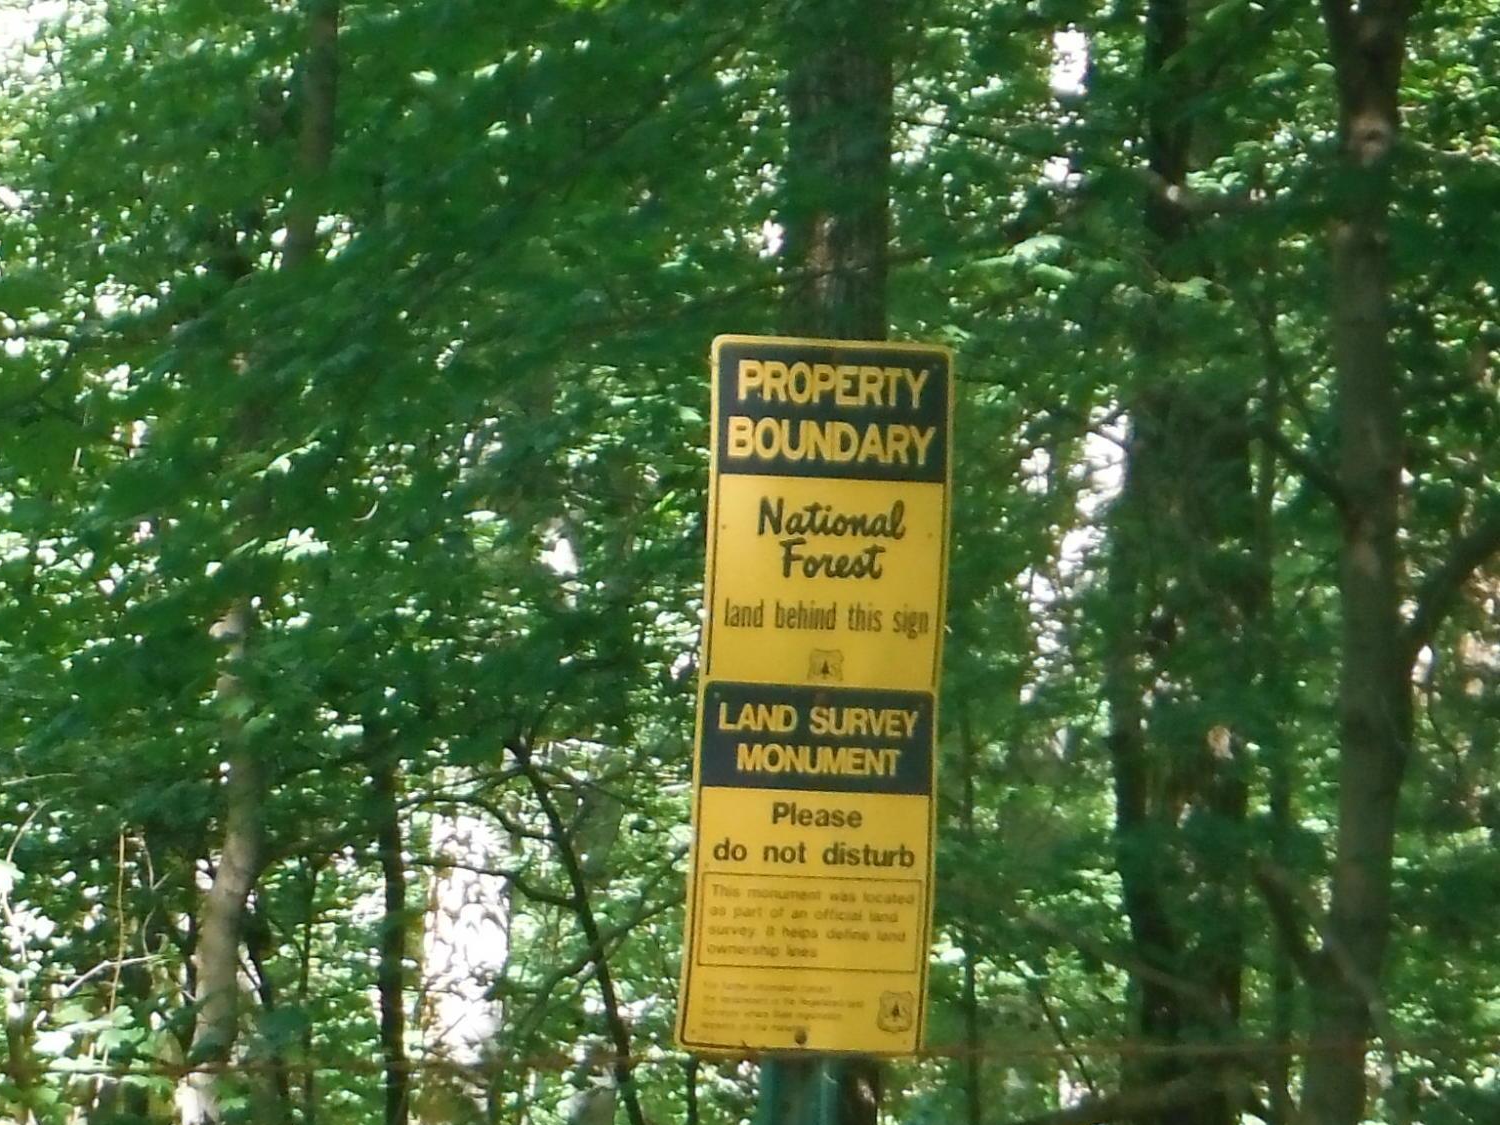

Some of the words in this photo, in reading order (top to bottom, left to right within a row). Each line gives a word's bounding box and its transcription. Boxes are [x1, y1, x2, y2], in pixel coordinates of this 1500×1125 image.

[737, 359, 929, 409] PROPERTY
[727, 415, 937, 466] BOUNDARY
[758, 495, 906, 540] National
[779, 537, 886, 579] Forest
[724, 597, 764, 628] land
[775, 600, 837, 631] behind
[848, 602, 883, 633] this
[893, 603, 929, 640] sign
[718, 702, 798, 733] LAND
[809, 706, 919, 738] SURVEY
[736, 743, 901, 777] MONUMENT
[772, 801, 863, 829] Please
[713, 837, 748, 862] do
[763, 841, 807, 864] not
[822, 841, 916, 868] disturb
[712, 884, 740, 898] This
[747, 887, 821, 901] monument
[829, 891, 856, 903] was
[863, 891, 915, 905] located
[733, 906, 762, 919] part
[769, 906, 784, 918] of
[791, 909, 808, 920] an
[814, 907, 862, 921] official
[869, 909, 899, 923] land
